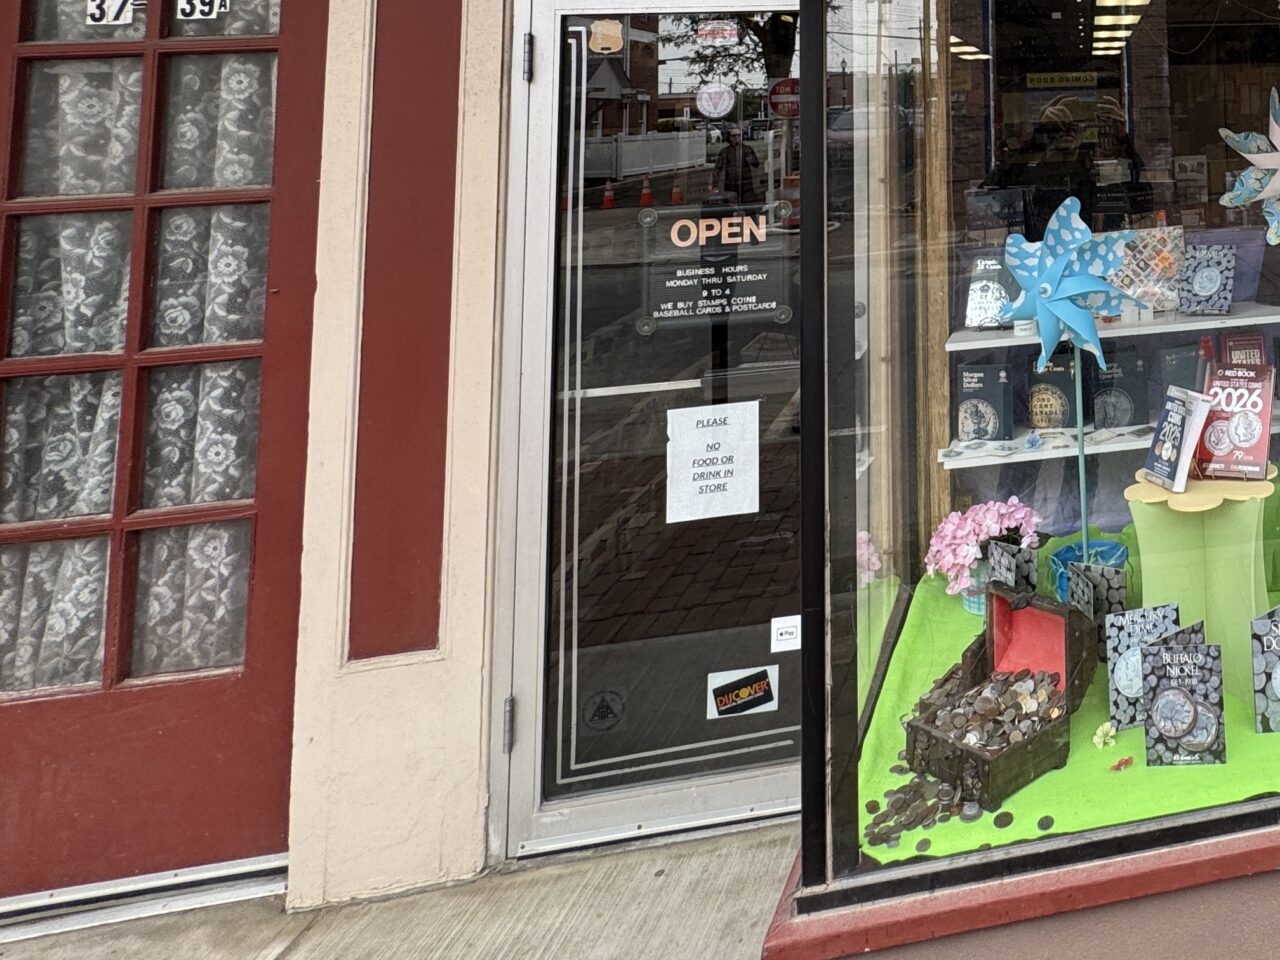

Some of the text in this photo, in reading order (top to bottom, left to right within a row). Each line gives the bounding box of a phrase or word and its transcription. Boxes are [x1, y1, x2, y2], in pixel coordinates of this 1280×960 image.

[670, 214, 767, 248] OPEN
[676, 265, 749, 277] BUSINESS HOURS
[665, 273, 768, 287] MONDAY THRU SATURDAY
[702, 289, 708, 297] 9
[660, 302, 673, 310] WE
[677, 300, 694, 309] BUY
[697, 298, 728, 307] STAMPS
[652, 309, 694, 319] BASEBALL
[696, 307, 722, 315] CARDS
[724, 305, 731, 313] &
[1231, 349, 1261, 360] UNITED
[1237, 370, 1257, 378] BOOK
[1230, 380, 1248, 388] STATES
[1248, 381, 1263, 389] COINS
[1209, 386, 1264, 414] 2026
[695, 416, 729, 429] PLEASE
[1158, 421, 1182, 447] 2025
[706, 442, 721, 452] NO
[692, 455, 734, 468] FOOD OR
[692, 468, 734, 481] DRINK IN
[698, 482, 728, 494] STORE
[1119, 609, 1166, 625] MERCURY
[784, 630, 795, 638] Pay
[1162, 652, 1202, 664] BUFFALO
[1166, 665, 1201, 677] NICKEL
[716, 679, 769, 708] DISCOVER
